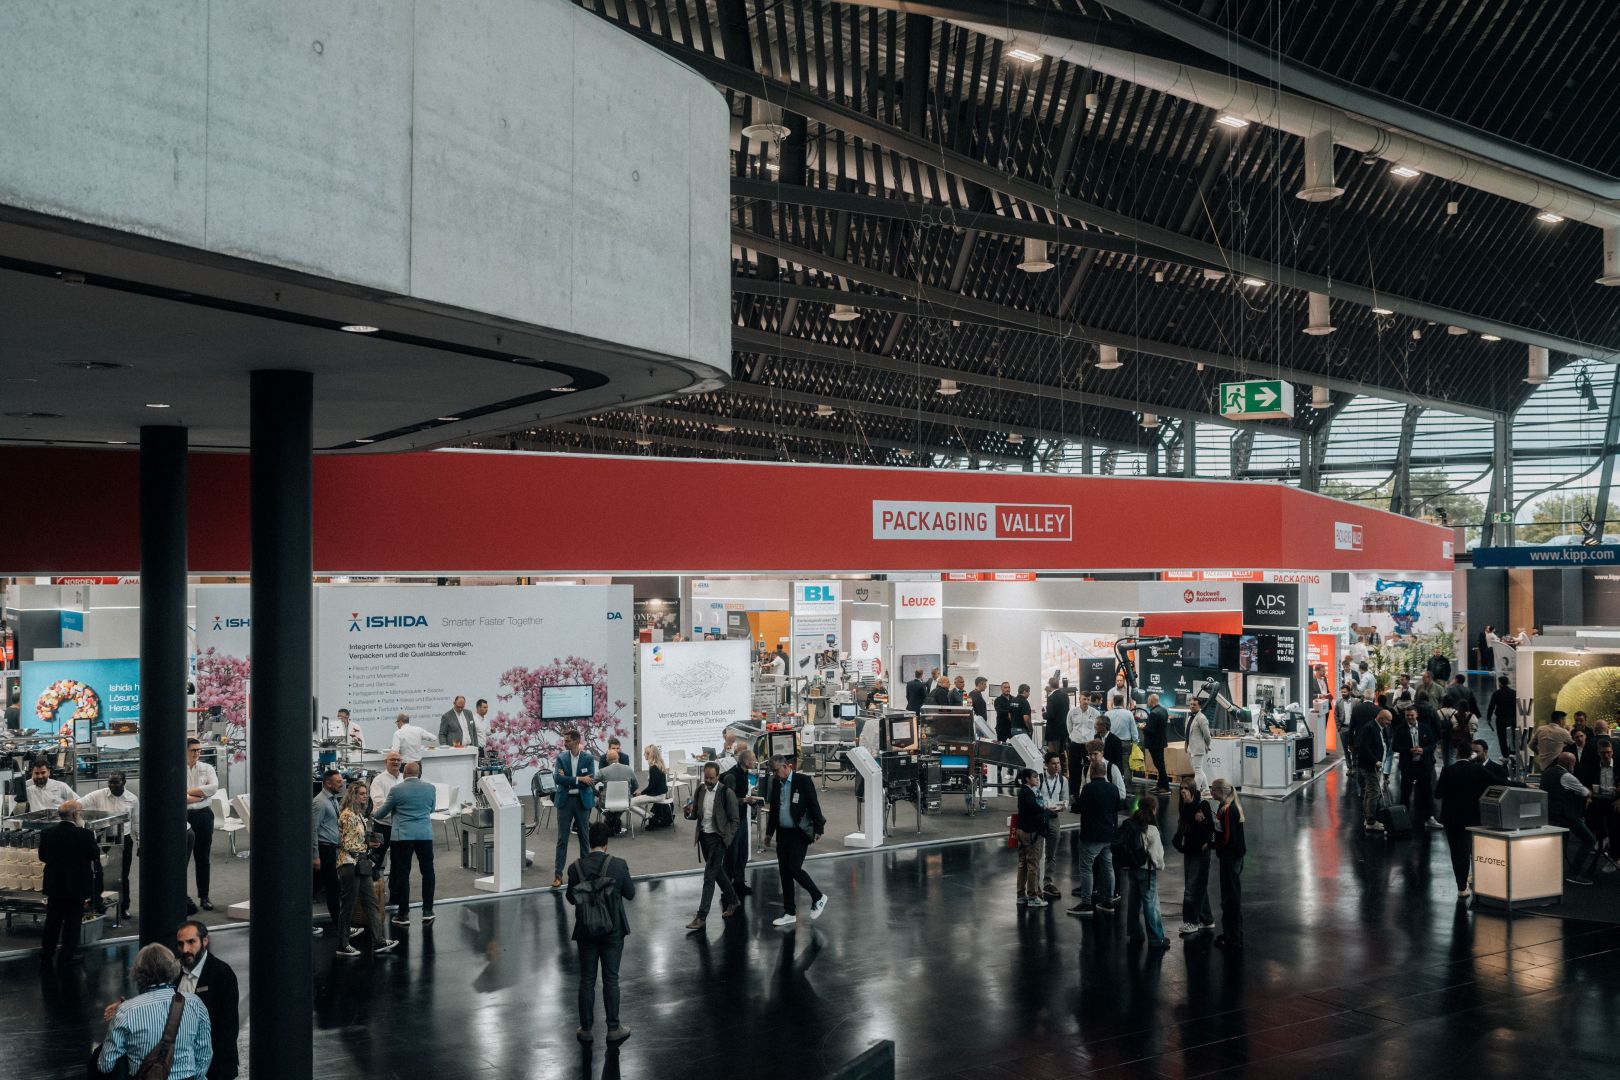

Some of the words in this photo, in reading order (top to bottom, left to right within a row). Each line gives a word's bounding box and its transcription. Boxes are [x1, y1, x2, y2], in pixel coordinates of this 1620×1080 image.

[882, 510, 988, 532] PACKAGING
[1002, 512, 1065, 533] VALLEY
[1530, 548, 1615, 564] www.kipp.com
[1274, 575, 1320, 584] PACKAGING
[804, 585, 835, 602] BL
[902, 595, 936, 607] Leuze
[606, 612, 623, 620] DA
[226, 618, 251, 628] ISH
[366, 616, 429, 628] ISHIDA
[441, 617, 476, 628] Smarter
[479, 616, 506, 626] Faster
[508, 616, 544, 628] Together
[349, 643, 382, 652] Integrierte
[384, 642, 416, 650] Lösungen
[440, 640, 474, 649] Verwägen,
[1093, 640, 1115, 648] Leuze
[349, 652, 384, 660] Verpacken
[398, 650, 410, 658] die
[1541, 659, 1581, 667] SESOTEC
[109, 684, 132, 692] Ishida
[109, 694, 139, 703] Lösung
[712, 708, 736, 716] bedeutet
[1474, 854, 1506, 867] SESOTEC
